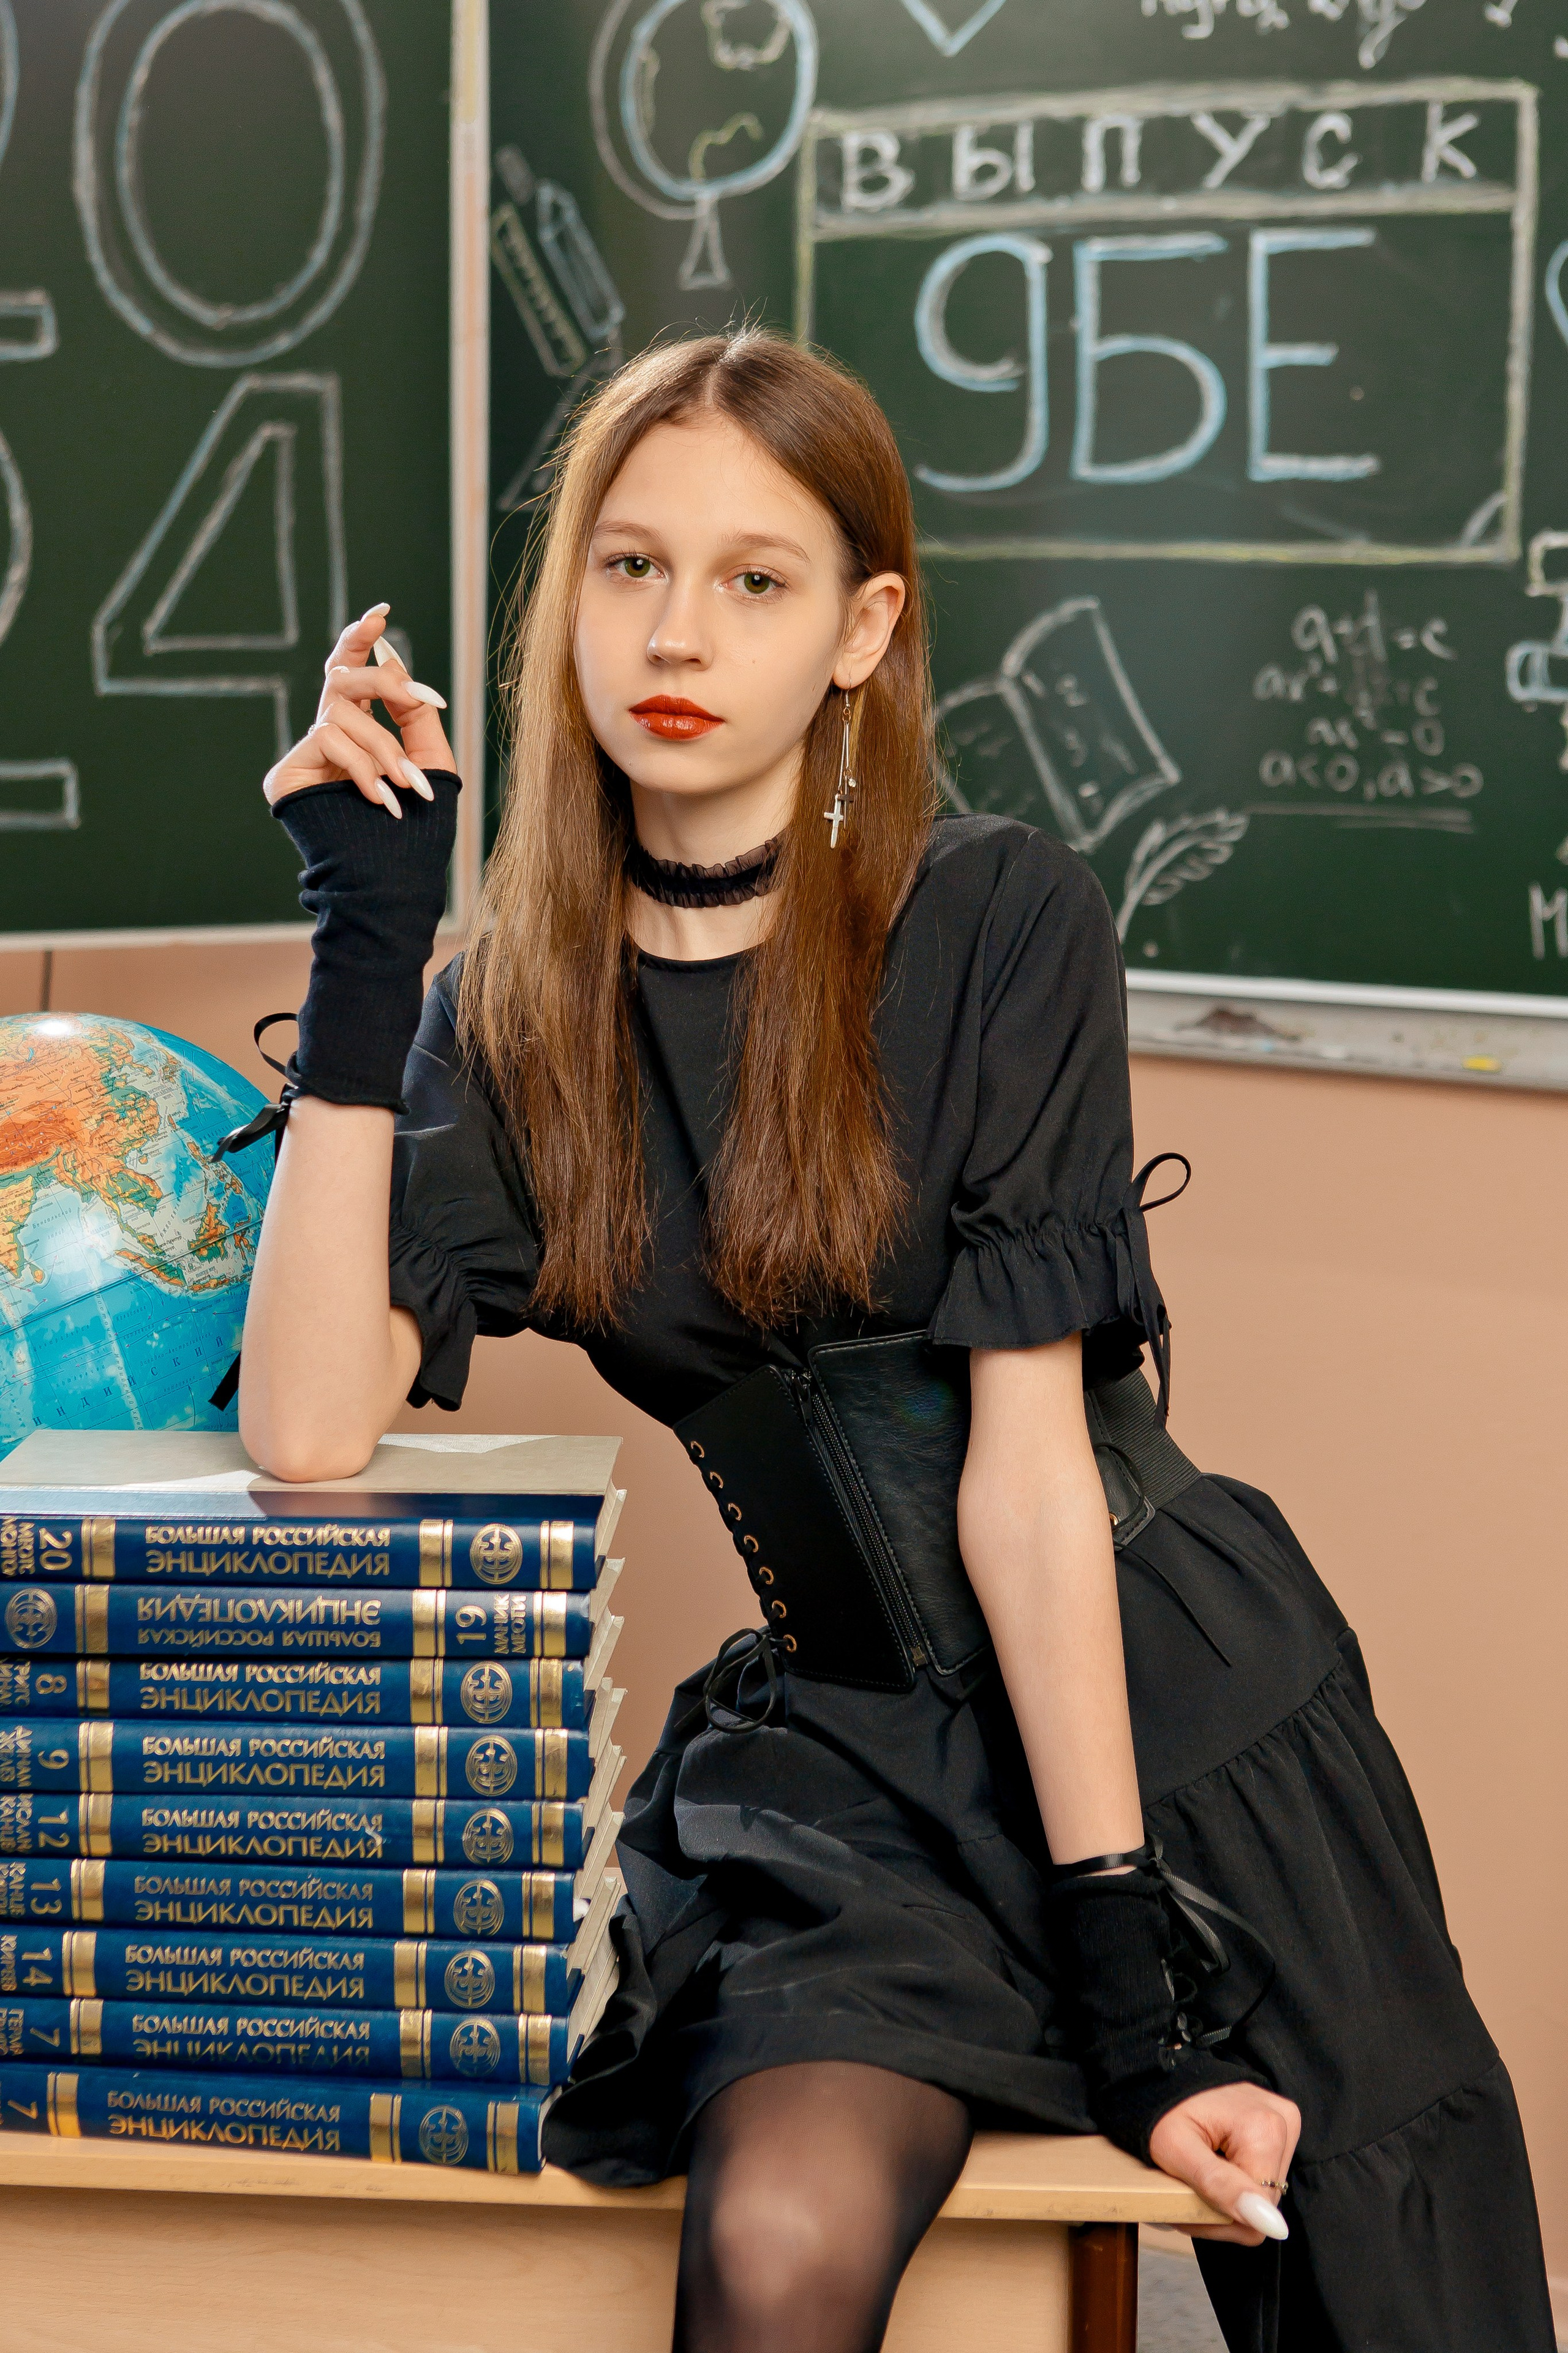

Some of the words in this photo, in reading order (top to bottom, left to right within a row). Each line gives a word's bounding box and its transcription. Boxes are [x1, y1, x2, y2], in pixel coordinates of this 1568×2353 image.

[839, 101, 1480, 210] ВЫПУСК
[39, 1527, 72, 1570] 20
[145, 1525, 245, 1544] БОЛЬШАЯ
[252, 1524, 391, 1547] РОССИЙСКАЯ
[145, 1549, 390, 1579] ЭНЦИКЛОПЕДИЯ
[137, 1593, 382, 1625] ЭНЦИКЛОПЕДИЯ
[138, 1628, 274, 1648] РОССИЙСКАЯ
[455, 1604, 487, 1645] 19
[282, 1630, 381, 1648] БОЛЬШАЯ
[36, 1673, 67, 1694] 8
[140, 1662, 239, 1682] БОЛЬШАЯ
[246, 1661, 381, 1685] РОССИЙСКАЯ
[140, 1686, 381, 1717] ЭНЦИКЛОПЕДИЯ
[37, 1749, 69, 1769] 9
[142, 1735, 242, 1757] БОЛЬШАЯ
[249, 1735, 386, 1759] РОССИЙСКАЯ
[143, 1761, 385, 1790] ЭНЦИКЛОПЕДИЯ
[38, 1808, 70, 1848] 12
[141, 1808, 240, 1829] БОЛЬШАЯ
[247, 1809, 383, 1832] РОССИЙСКАЯ
[142, 1834, 383, 1860] ЭНЦИКЛОПЕДИЯ
[31, 1878, 62, 1914] 13
[134, 1875, 232, 1896] БОЛЬШАЯ
[239, 1874, 374, 1902] РОССИЙСКАЯ
[135, 1900, 374, 1930] ЭНЦИКЛОПЕДИЯ
[21, 1947, 53, 1986] 14
[125, 1944, 223, 1966] БОЛЬШАЯ
[230, 1947, 365, 1971] РОССИЙСКАЯ
[125, 1969, 365, 2001] ЭНЦИКЛОПЕДИЯ
[30, 2027, 60, 2047] 7
[132, 2014, 229, 2036] БОЛЬШАЯ
[236, 2016, 371, 2041] РОССИЙСКАЯ
[7, 2100, 38, 2120] 7
[107, 2090, 202, 2113] БОЛЬШАЯ
[209, 2098, 341, 2123] РОССИЙСКАЯ
[108, 2113, 341, 2151] ЭНЦИКЛОПЕДИЯ
